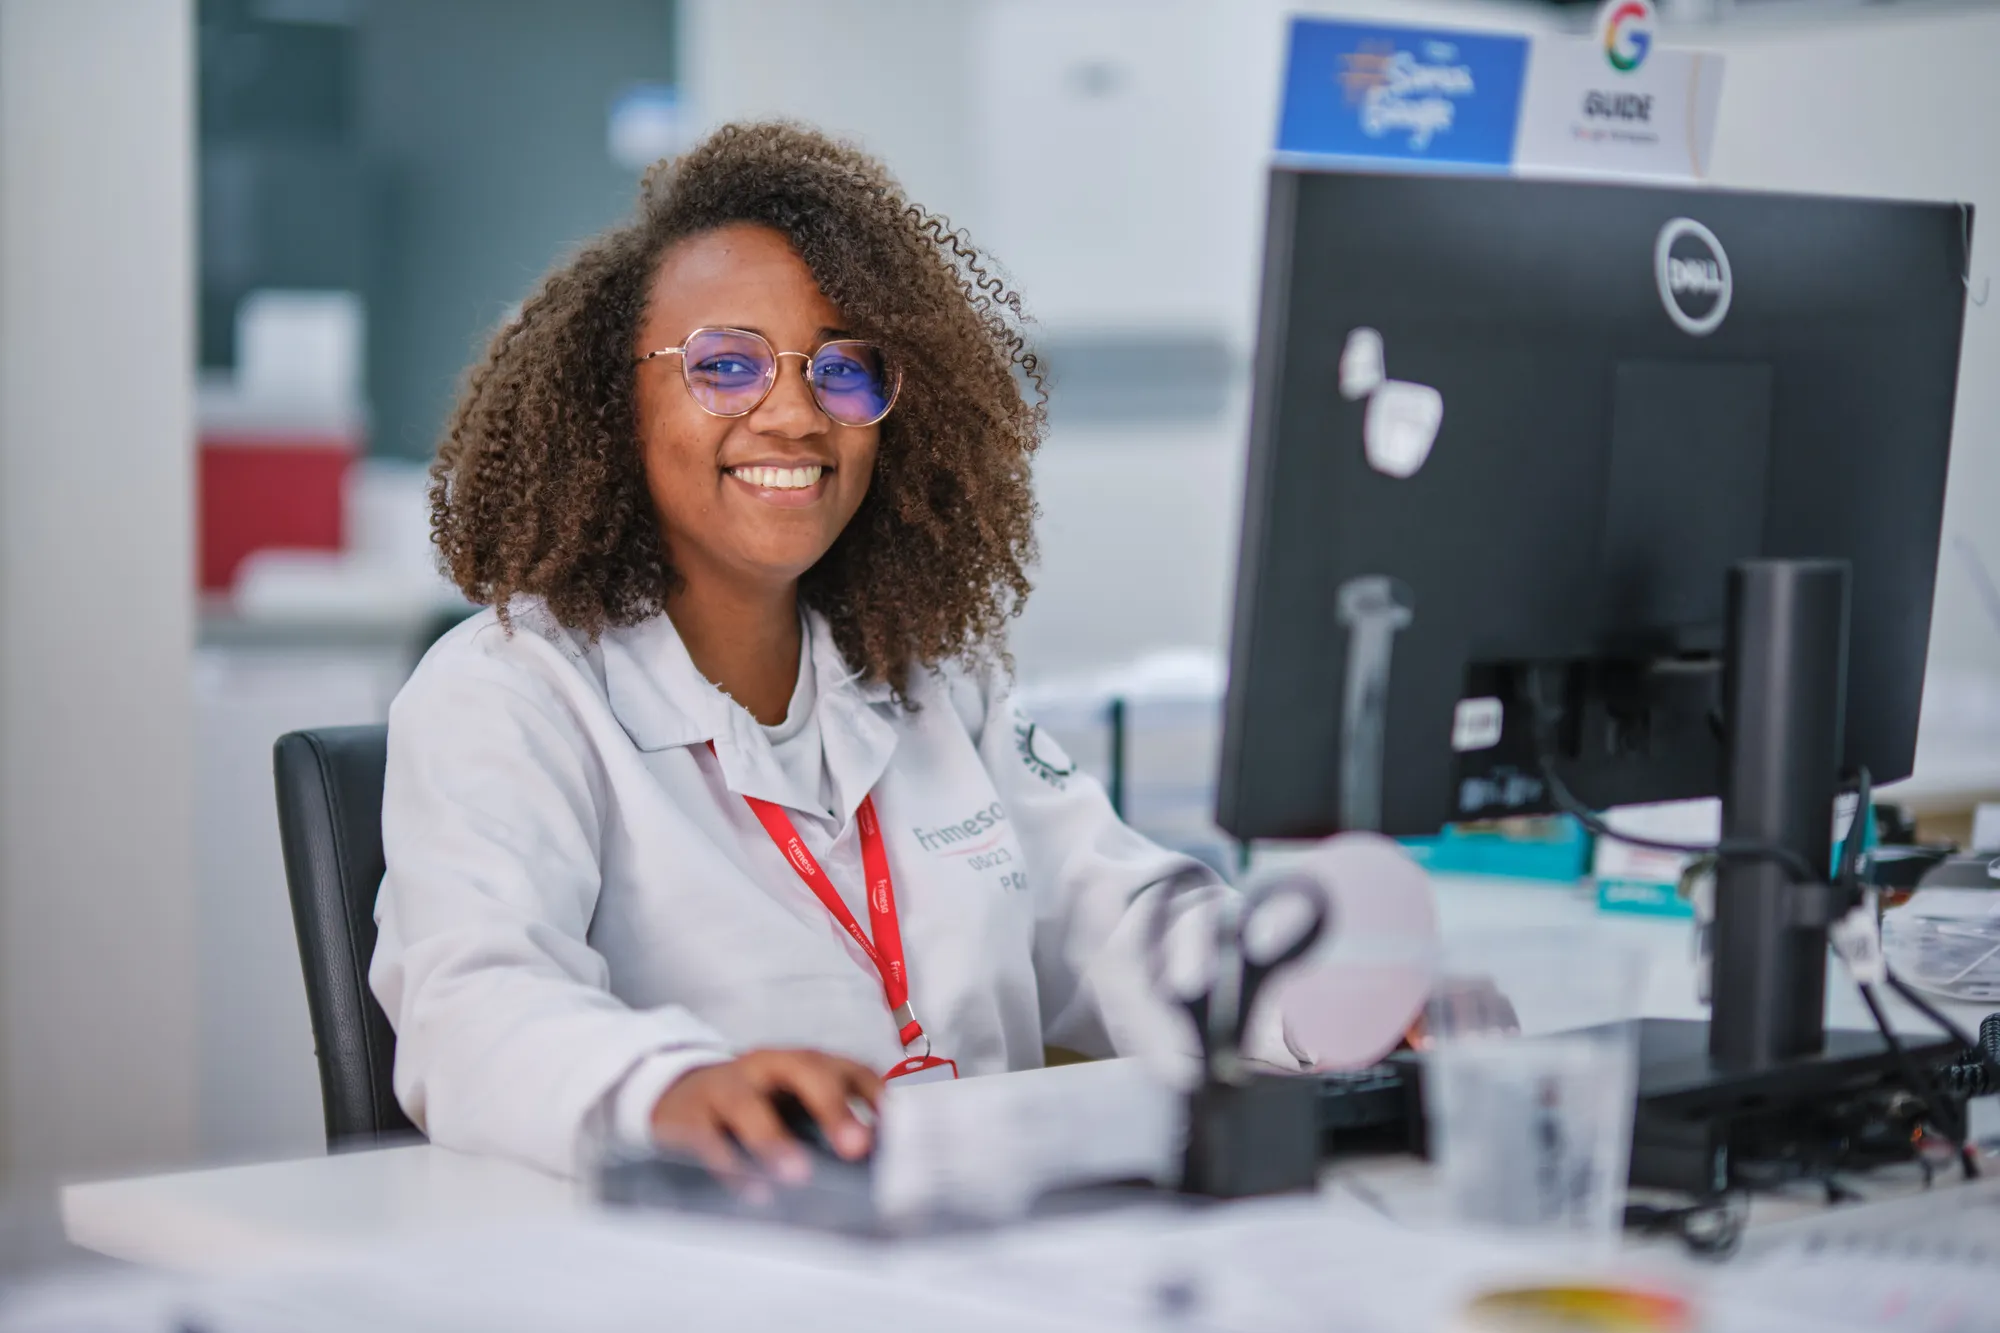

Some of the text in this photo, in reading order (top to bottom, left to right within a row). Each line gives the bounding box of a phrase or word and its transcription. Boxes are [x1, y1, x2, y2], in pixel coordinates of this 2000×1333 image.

[1606, 3, 1651, 72] G
[1583, 89, 1654, 122] GUIDE
[1668, 257, 1721, 293] DELL
